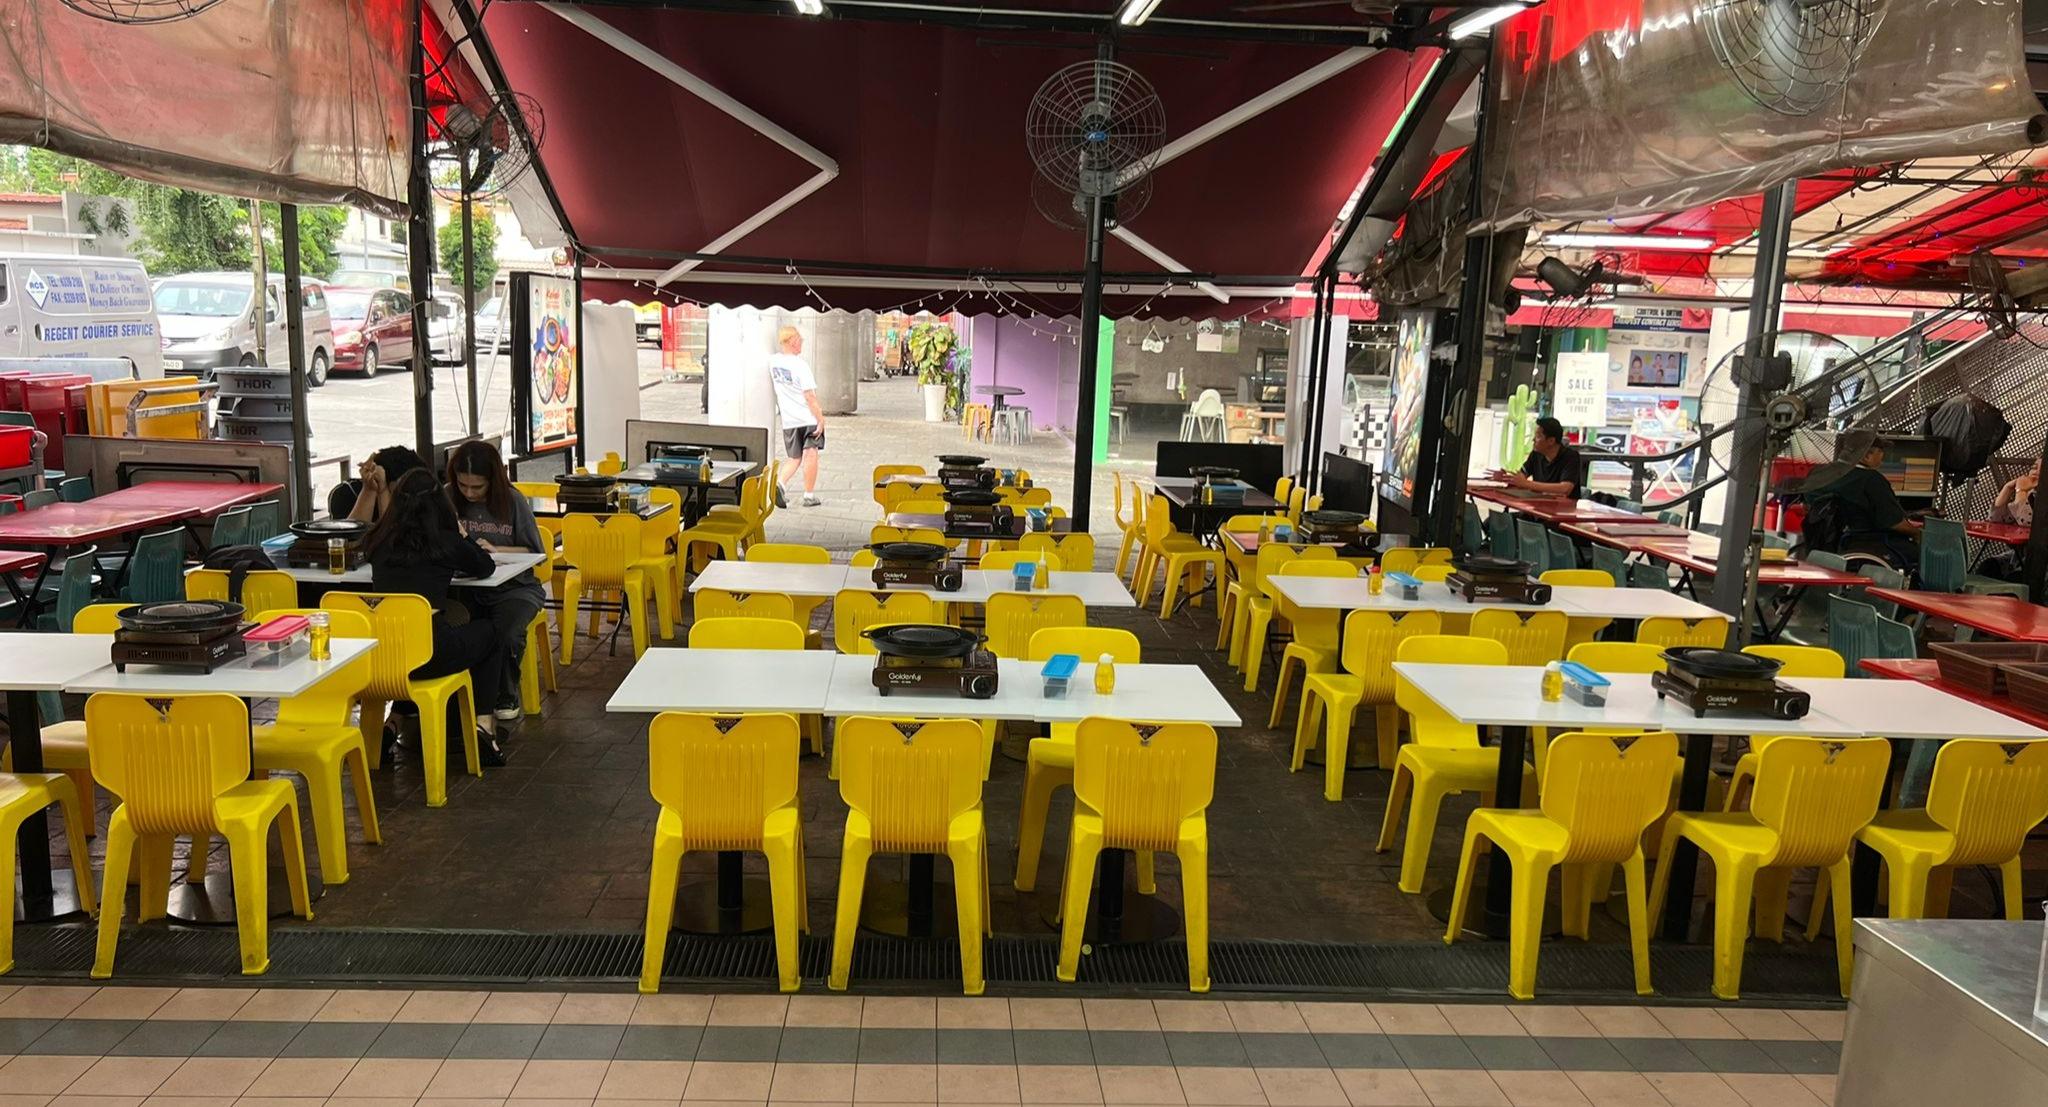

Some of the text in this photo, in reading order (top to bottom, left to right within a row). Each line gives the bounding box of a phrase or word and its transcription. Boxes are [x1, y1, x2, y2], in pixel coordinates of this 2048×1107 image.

[1641, 317, 1667, 327] CONTACT
[45, 323, 154, 341] REGENT COURIER SERVICE
[234, 378, 272, 390] THOR
[1567, 379, 1593, 390] SALE
[224, 425, 258, 436] THOR
